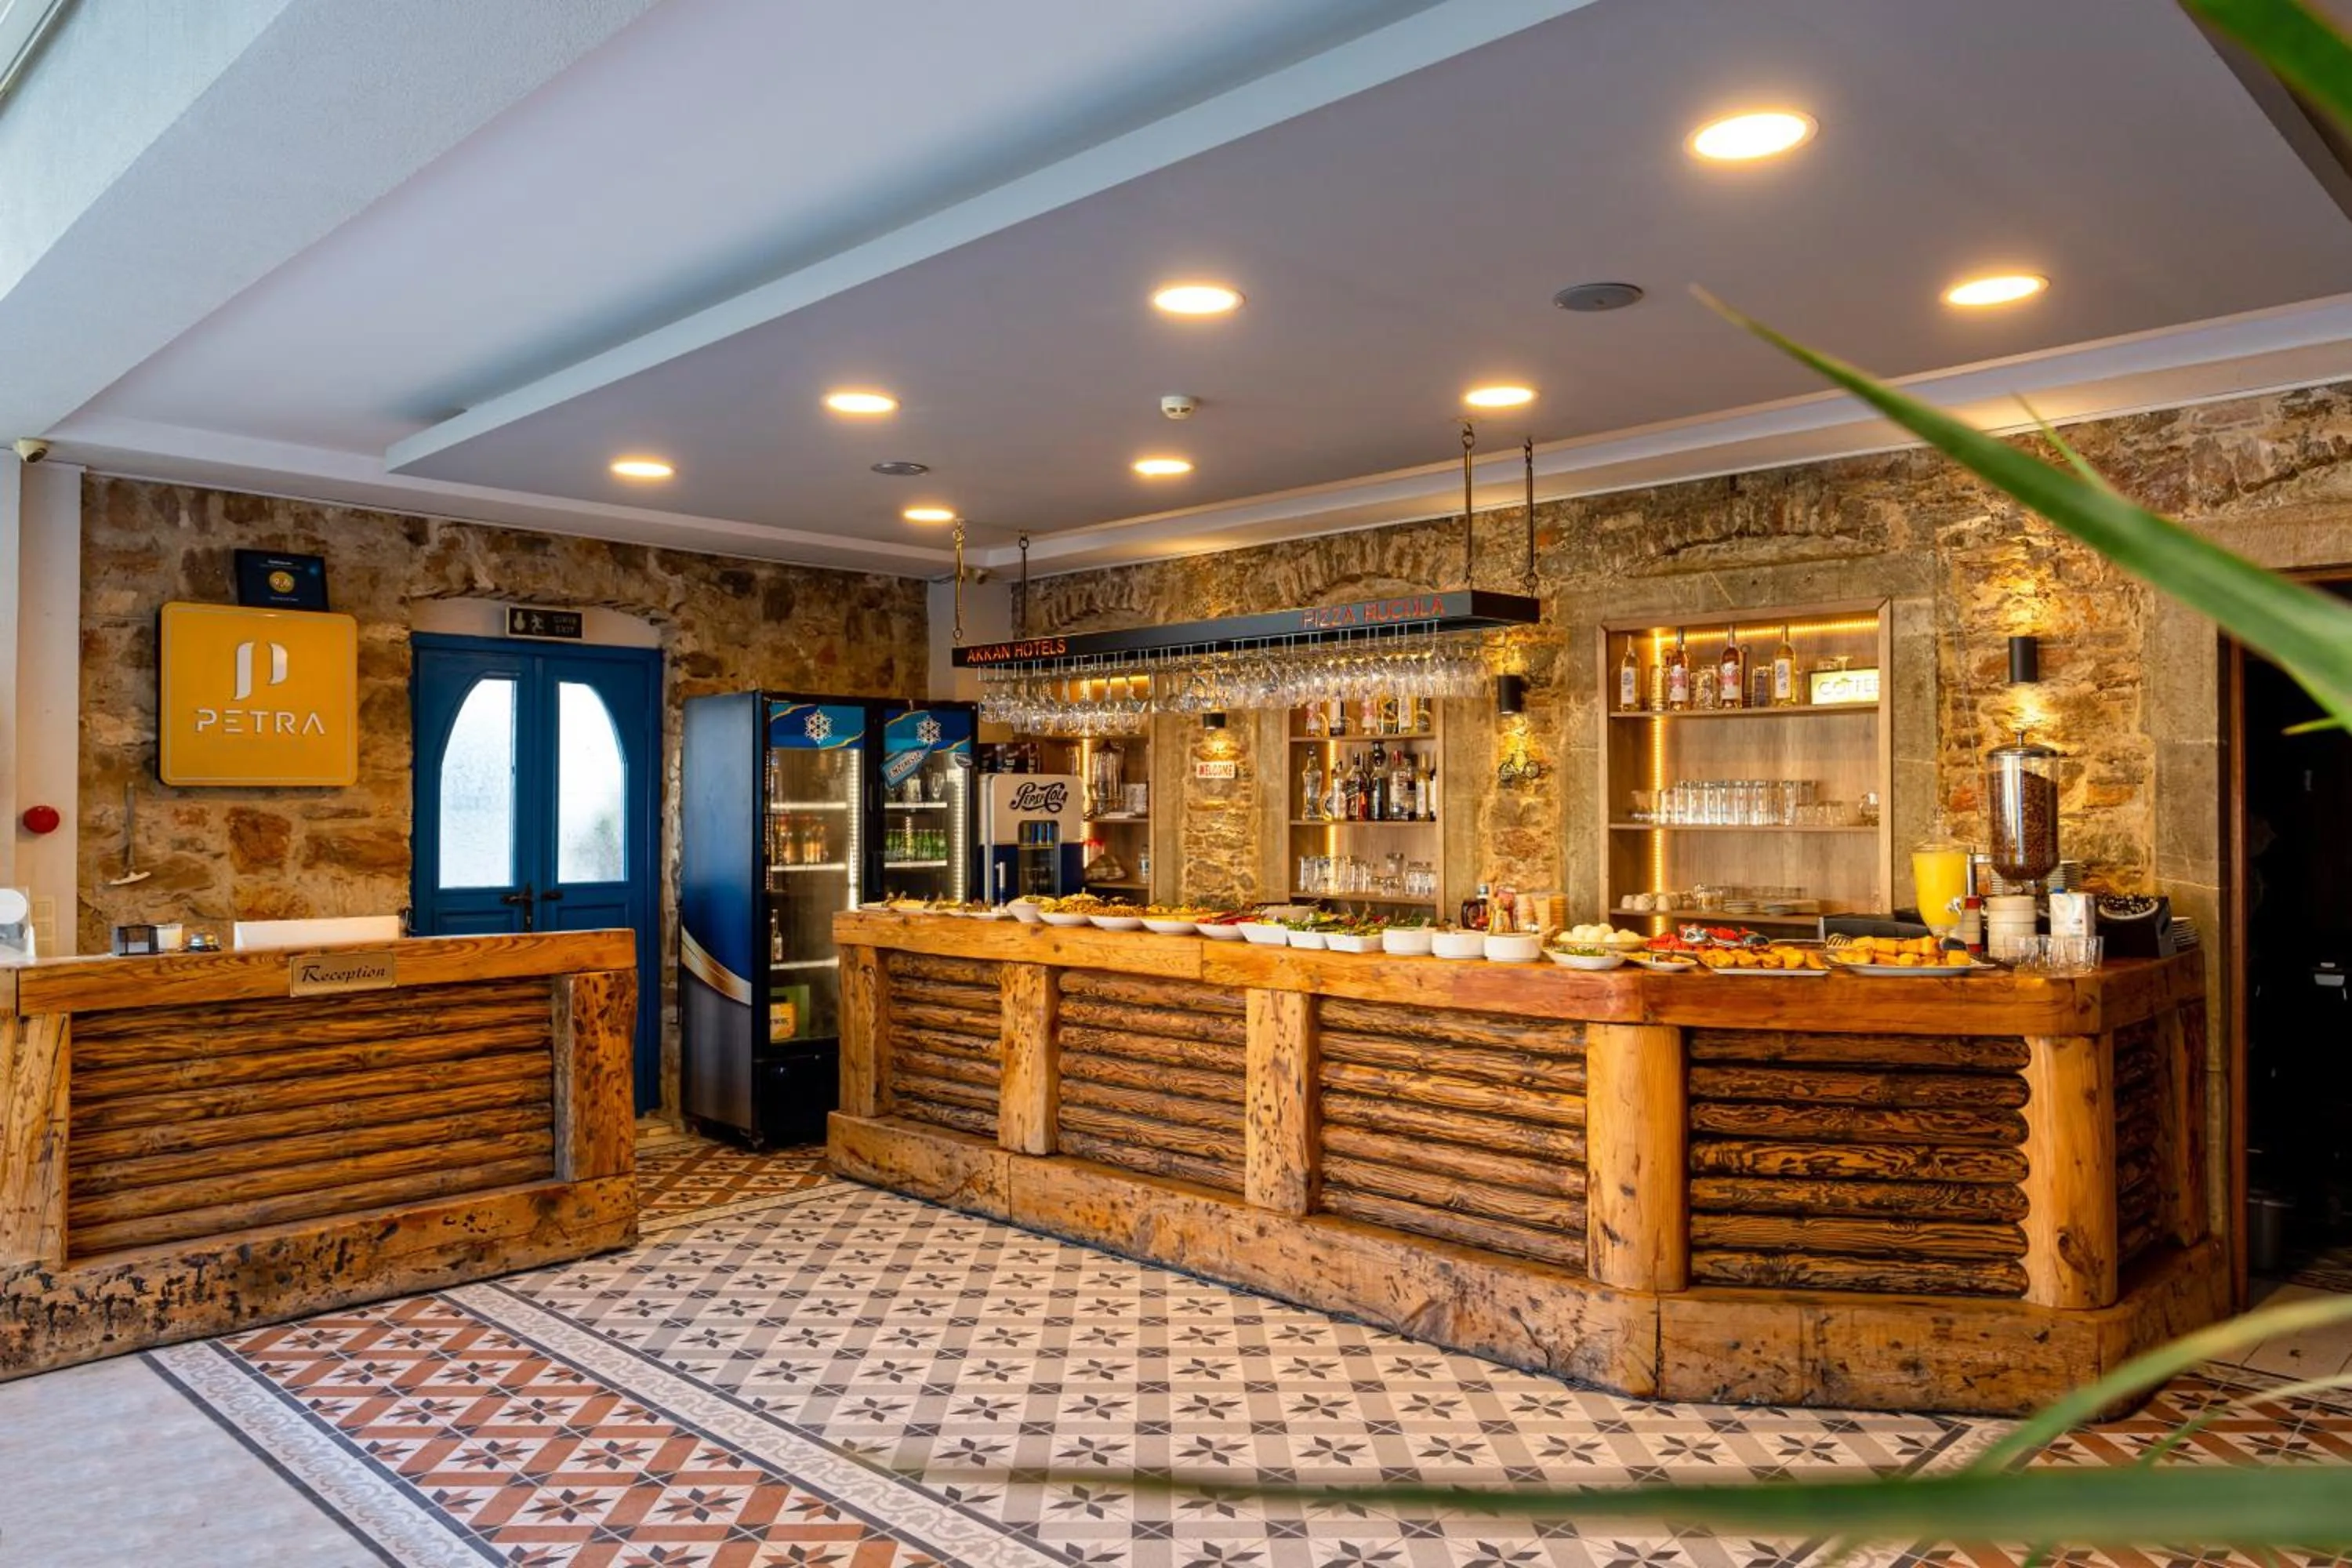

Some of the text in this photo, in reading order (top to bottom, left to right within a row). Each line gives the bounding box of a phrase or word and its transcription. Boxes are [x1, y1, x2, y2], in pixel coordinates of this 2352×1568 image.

[1302, 605, 1356, 628] PIZZA
[967, 639, 1066, 663] AKKAN HOTELS
[195, 708, 325, 735] PETRA
[301, 964, 386, 983] Reception
